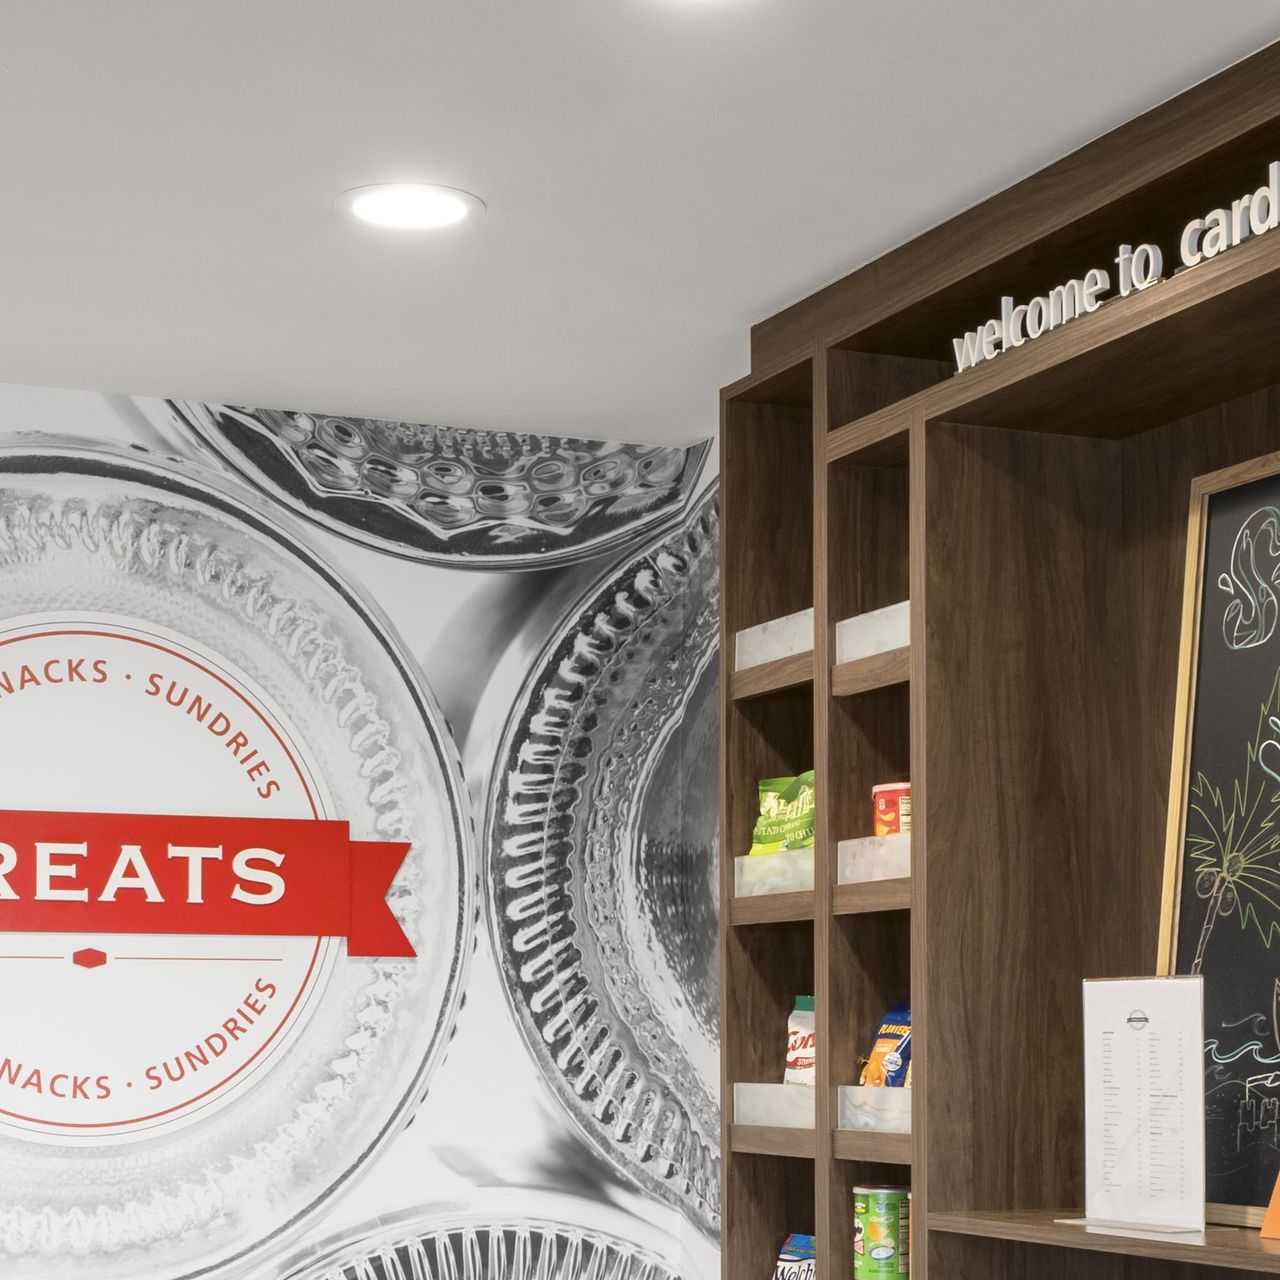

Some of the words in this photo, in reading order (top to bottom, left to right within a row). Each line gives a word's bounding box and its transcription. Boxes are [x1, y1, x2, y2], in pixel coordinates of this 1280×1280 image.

[953, 268, 1110, 373] welcome
[1115, 243, 1162, 297] to
[146, 672, 281, 800] SUNDRIES
[146, 977, 277, 1091] SUNDRIES
